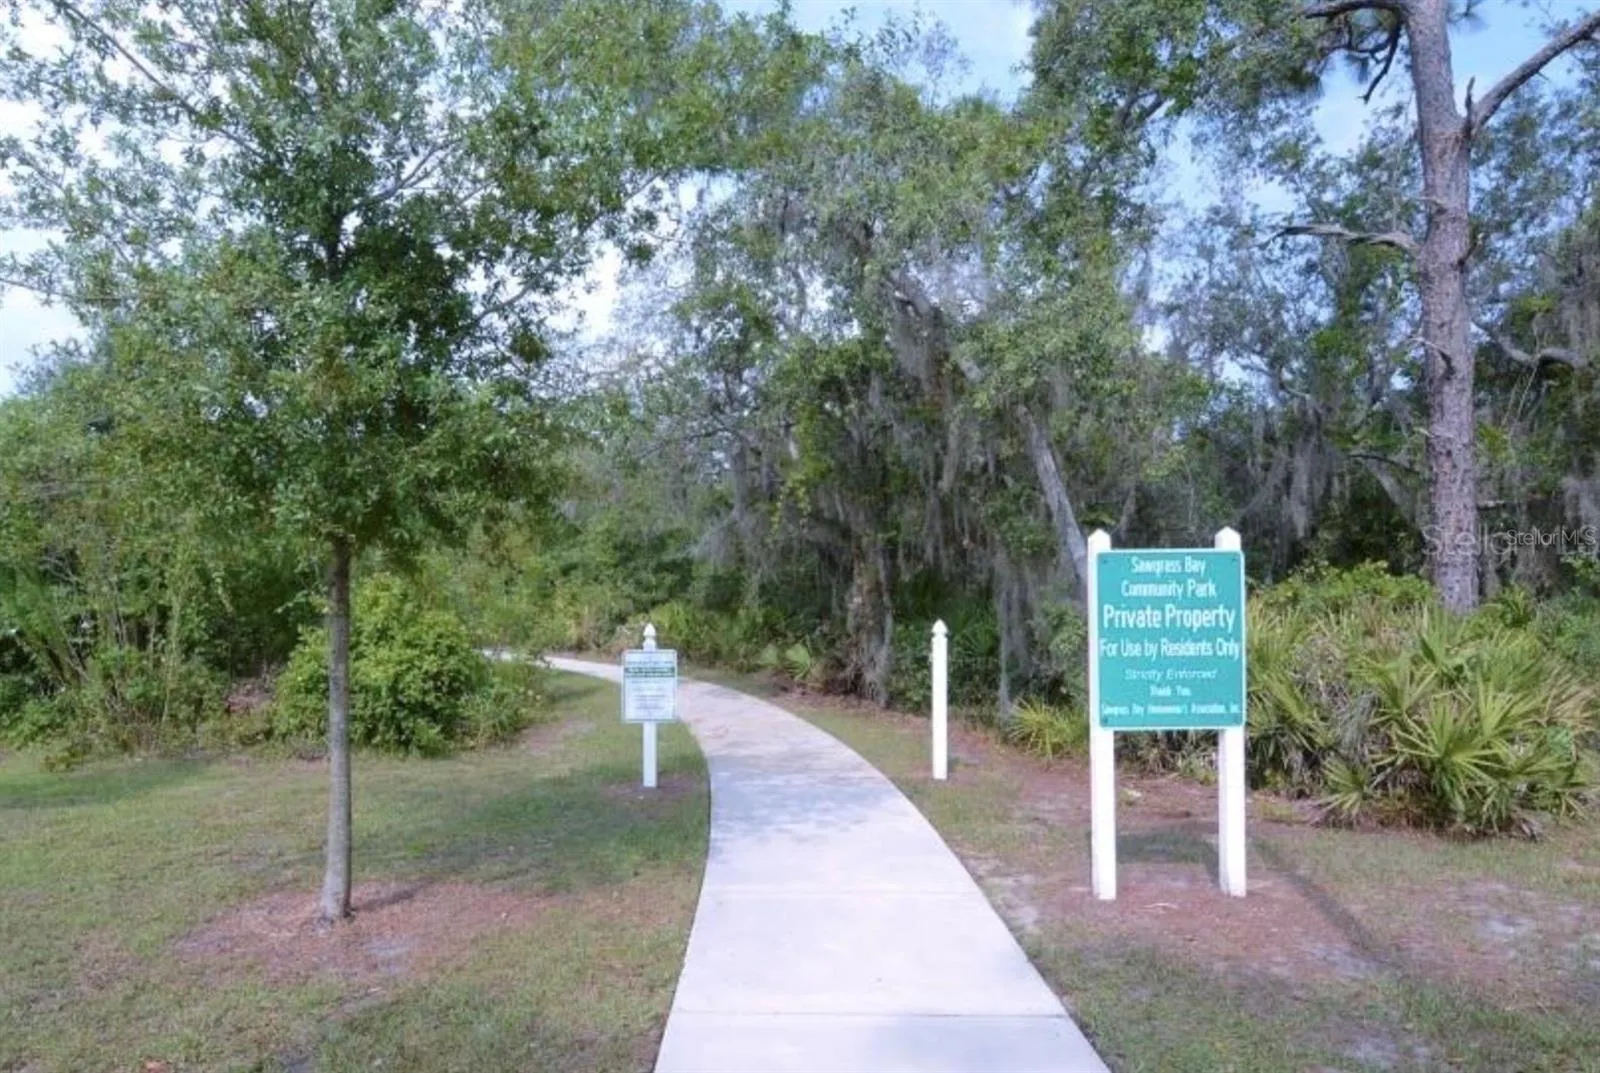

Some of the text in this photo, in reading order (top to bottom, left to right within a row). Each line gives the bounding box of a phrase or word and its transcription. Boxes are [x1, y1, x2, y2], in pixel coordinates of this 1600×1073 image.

[1131, 556, 1206, 575] Sawgrass Bay
[1121, 580, 1217, 600] Community Park
[1103, 604, 1236, 633] Private Property
[1100, 639, 1240, 661] For Use by Residents Only
[1125, 669, 1218, 680] Strictly Enforced
